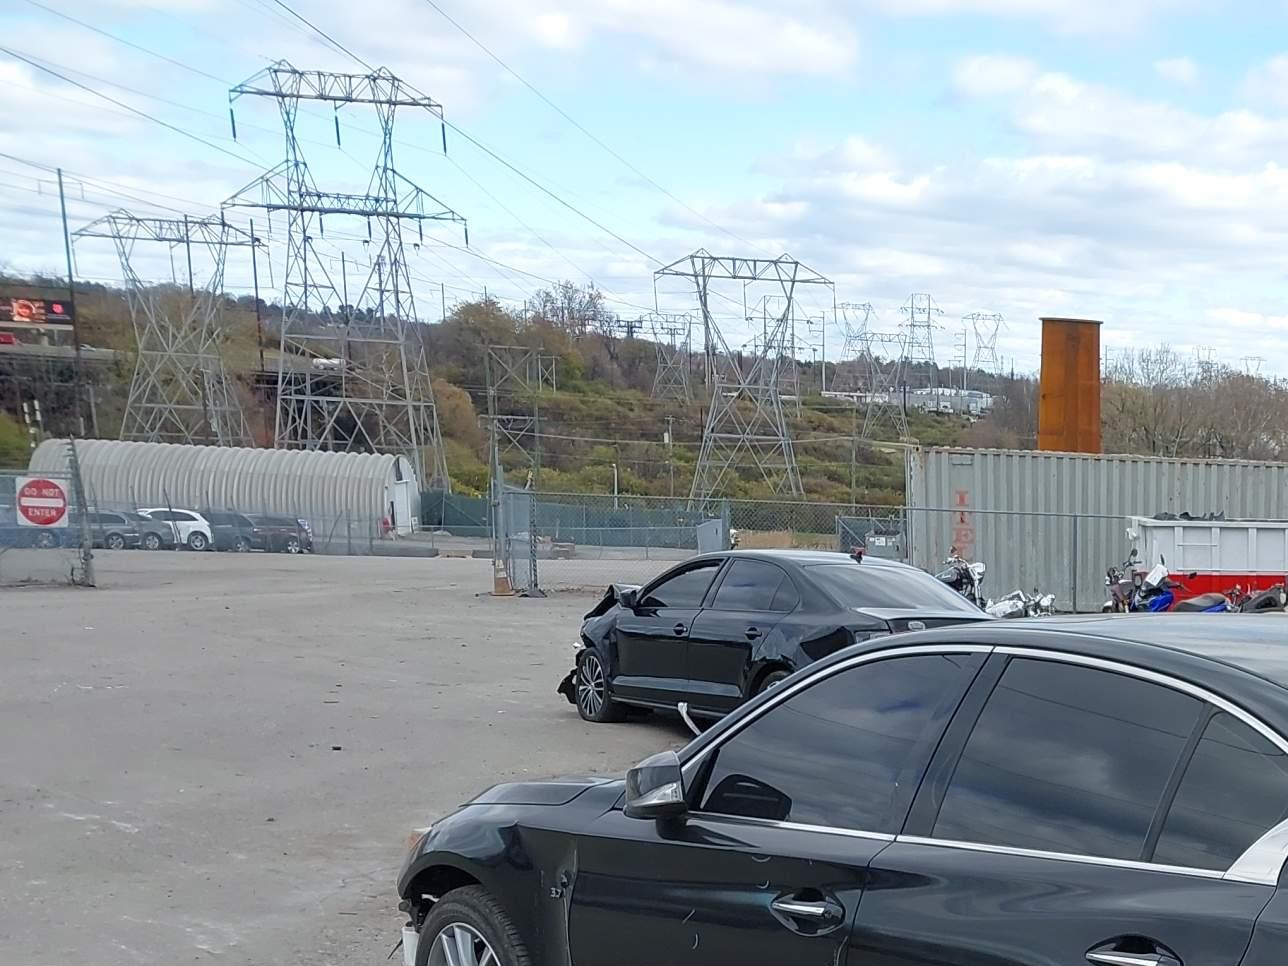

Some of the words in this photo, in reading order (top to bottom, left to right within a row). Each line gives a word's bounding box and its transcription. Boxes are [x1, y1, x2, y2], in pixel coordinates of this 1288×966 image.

[24, 487, 38, 497] DO
[42, 488, 61, 497] NOT
[28, 507, 58, 517] ENTER
